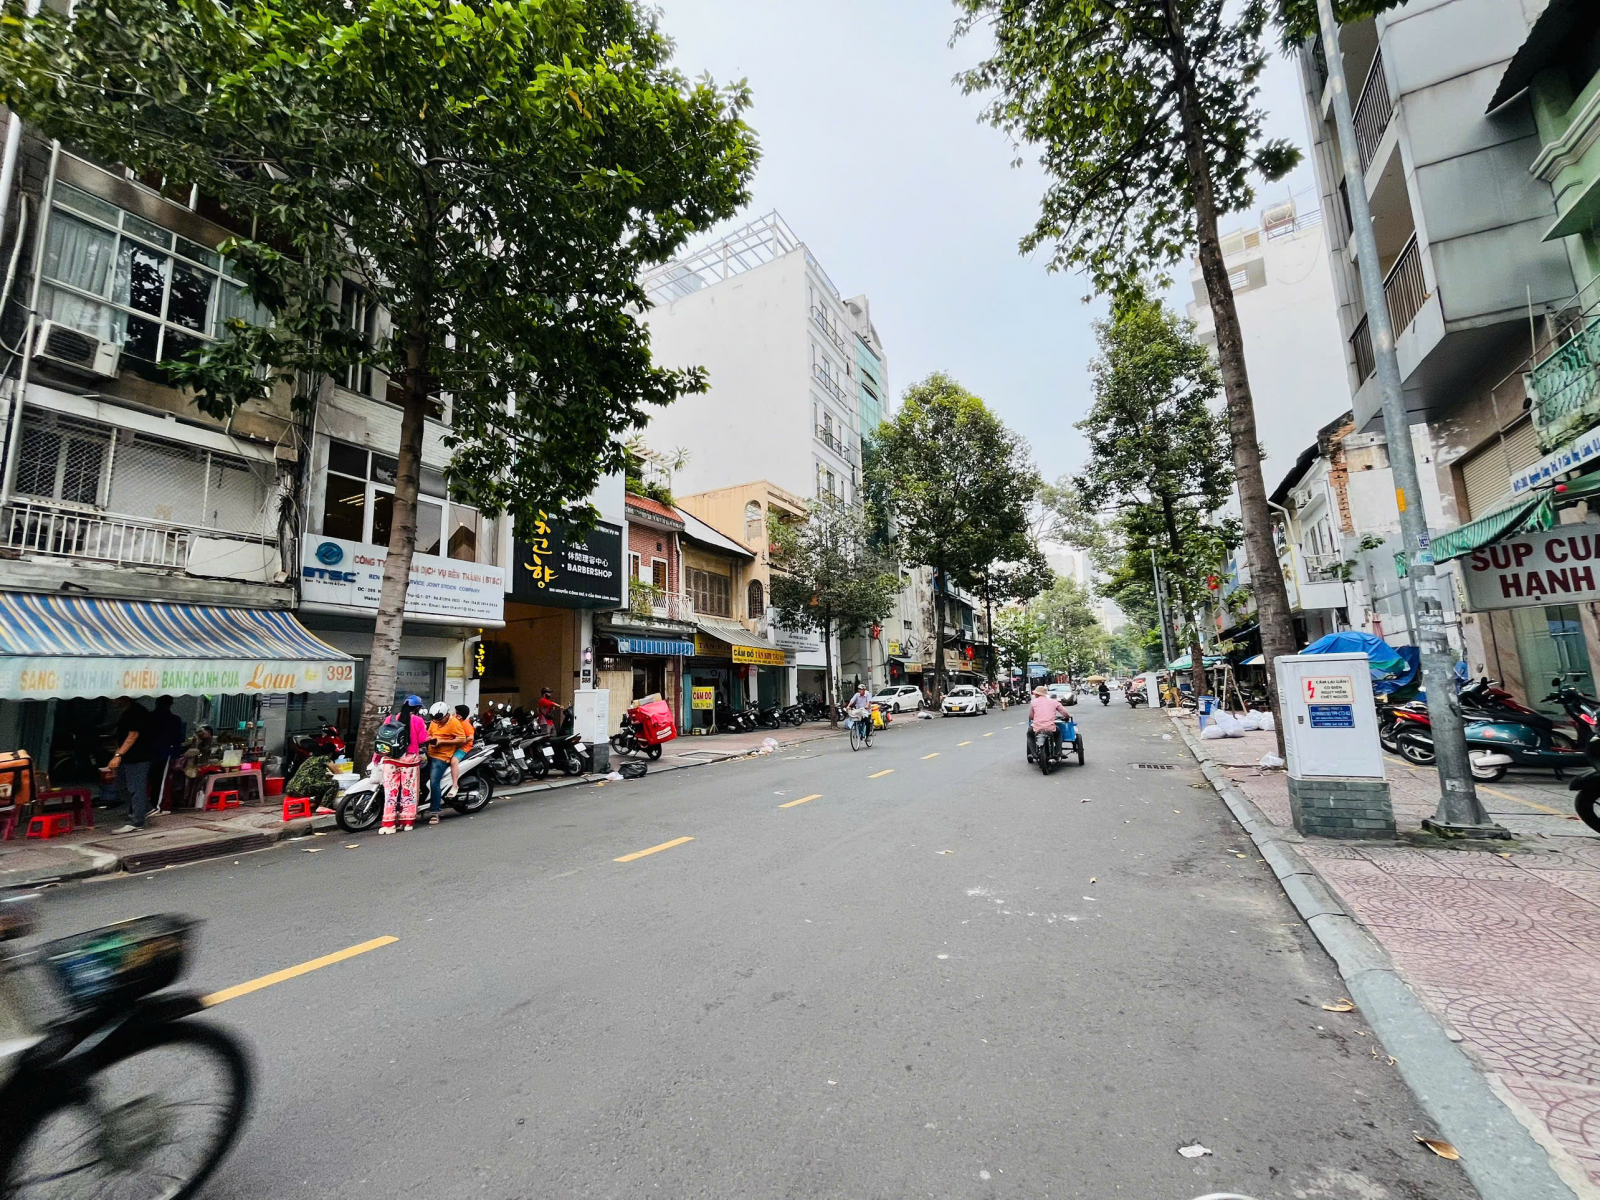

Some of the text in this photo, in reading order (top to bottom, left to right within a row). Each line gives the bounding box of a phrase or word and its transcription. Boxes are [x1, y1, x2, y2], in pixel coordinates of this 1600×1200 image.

[1545, 534, 1600, 563] CU
[376, 559, 387, 567] TY
[567, 563, 613, 579] BARBERSHOP
[302, 566, 357, 583] BTSC
[1499, 566, 1596, 601] HẠNH
[245, 663, 296, 690] Loan
[326, 665, 352, 681] 392
